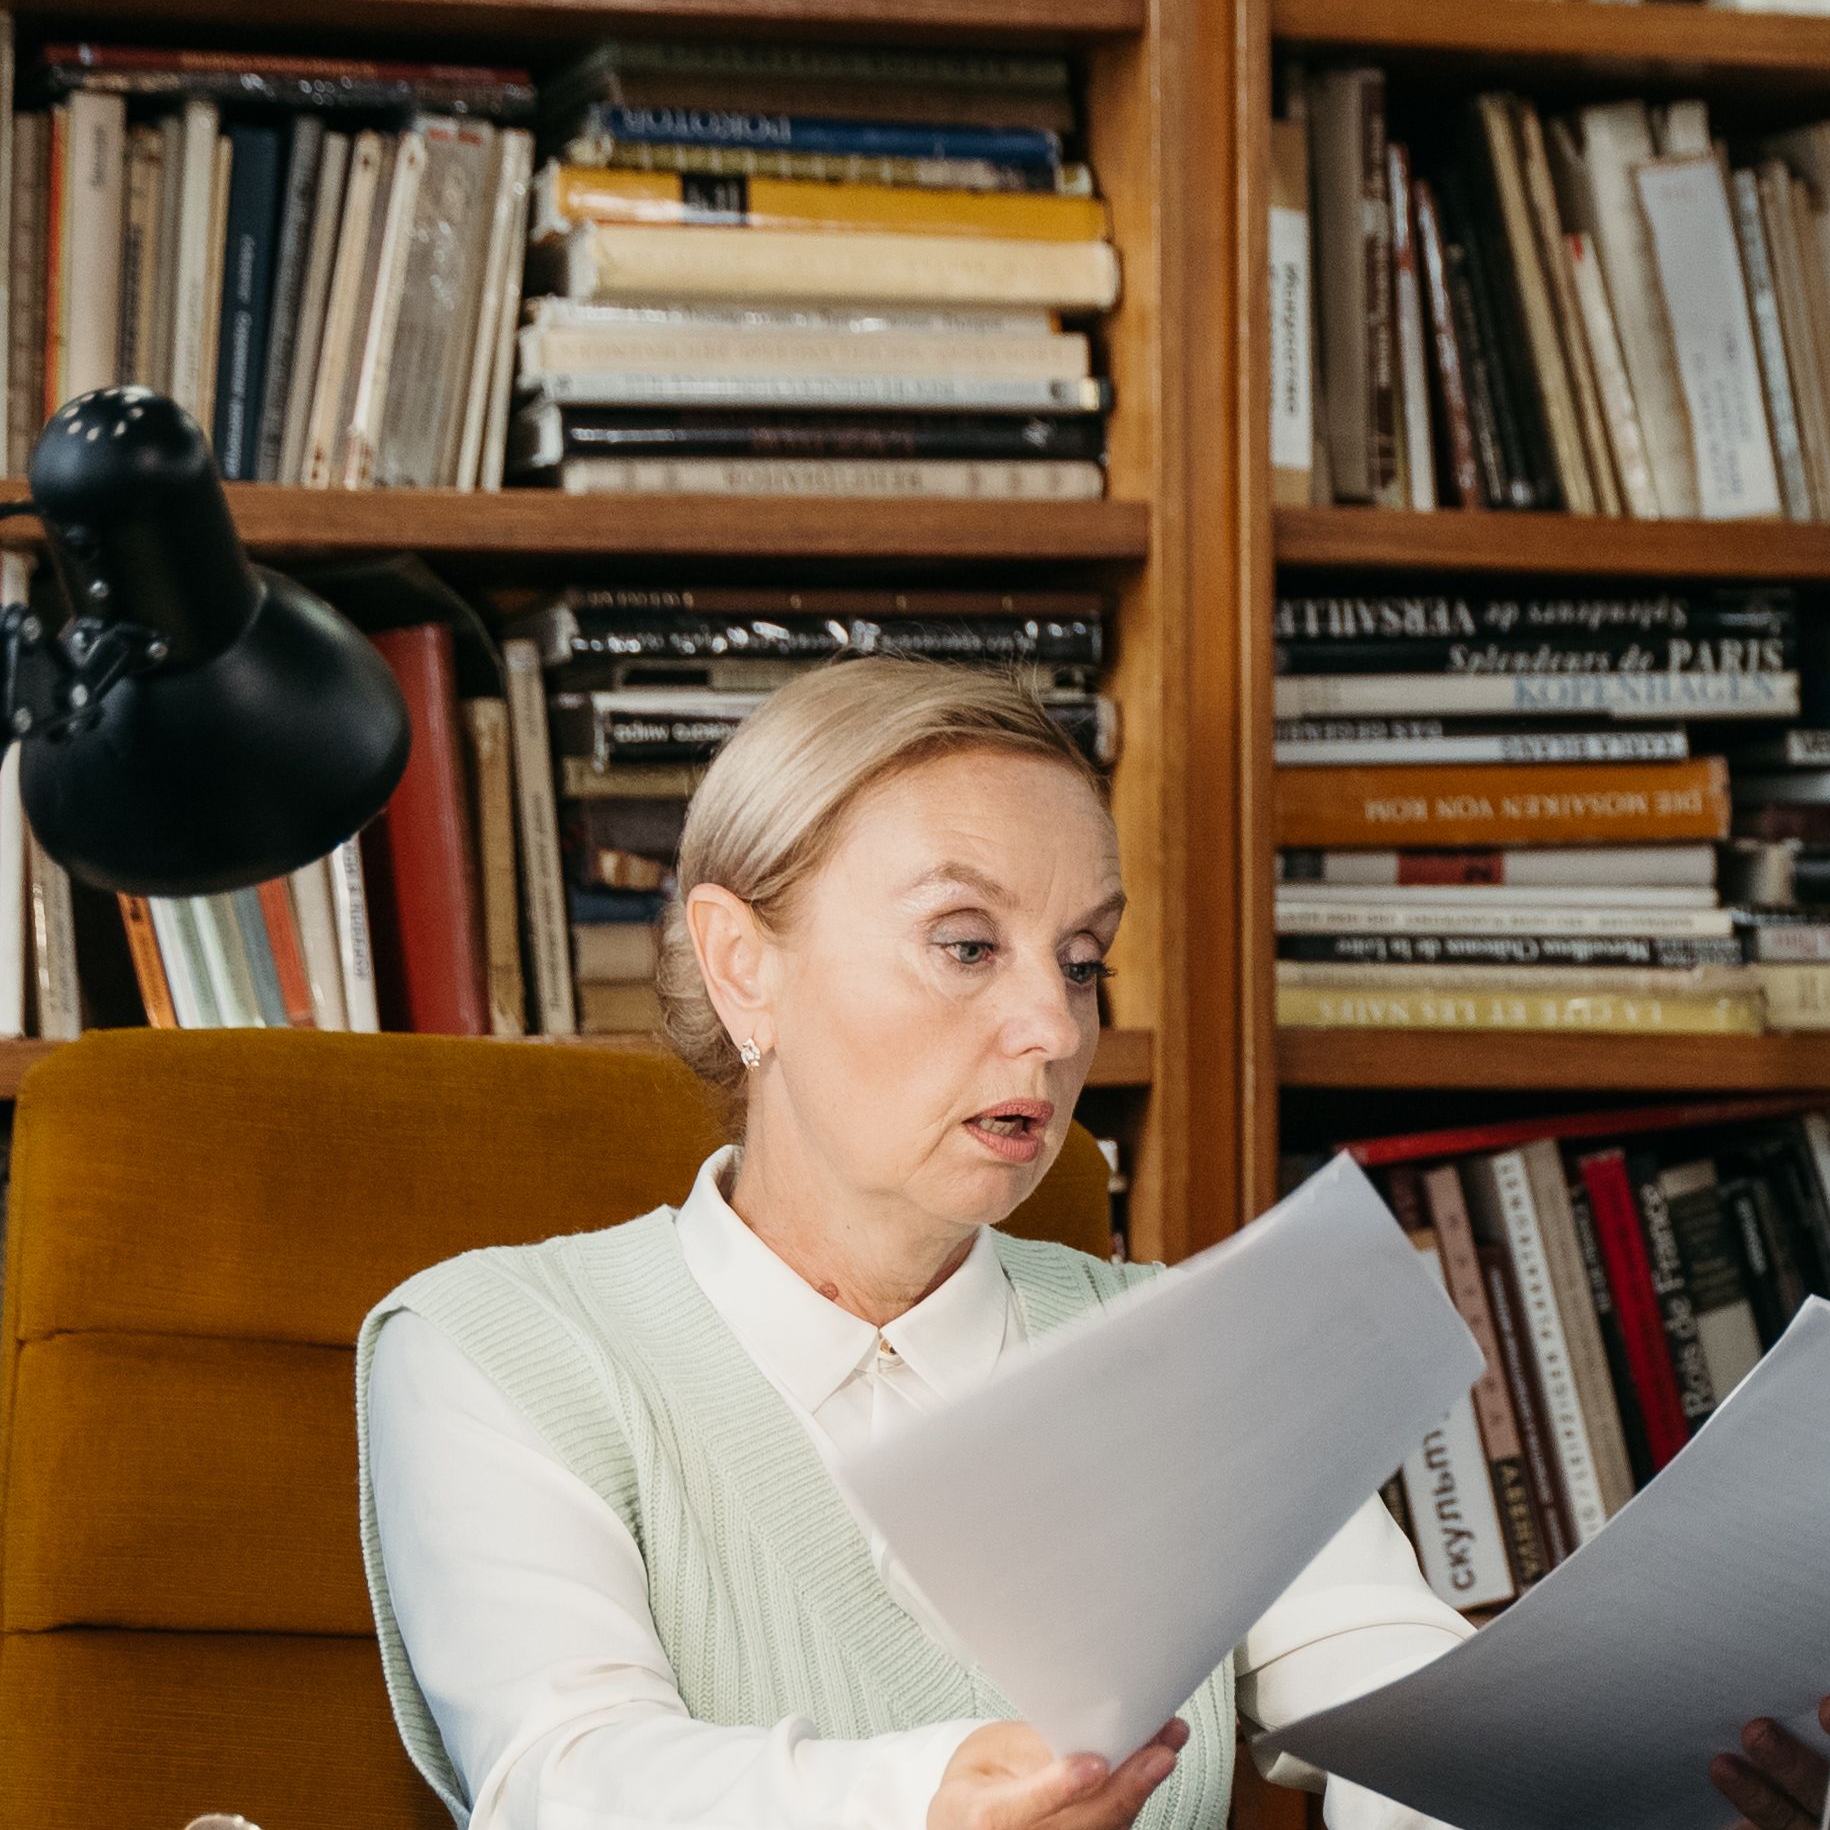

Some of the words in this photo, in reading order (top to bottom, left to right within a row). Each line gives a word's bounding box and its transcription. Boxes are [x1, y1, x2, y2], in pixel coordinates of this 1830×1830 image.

[1484, 599, 1519, 627] de
[1618, 643, 1656, 671] de
[1668, 637, 1785, 672] PARIS
[1364, 796, 1429, 823] ROM
[1437, 794, 1494, 820] VON
[1656, 789, 1702, 815] DIE
